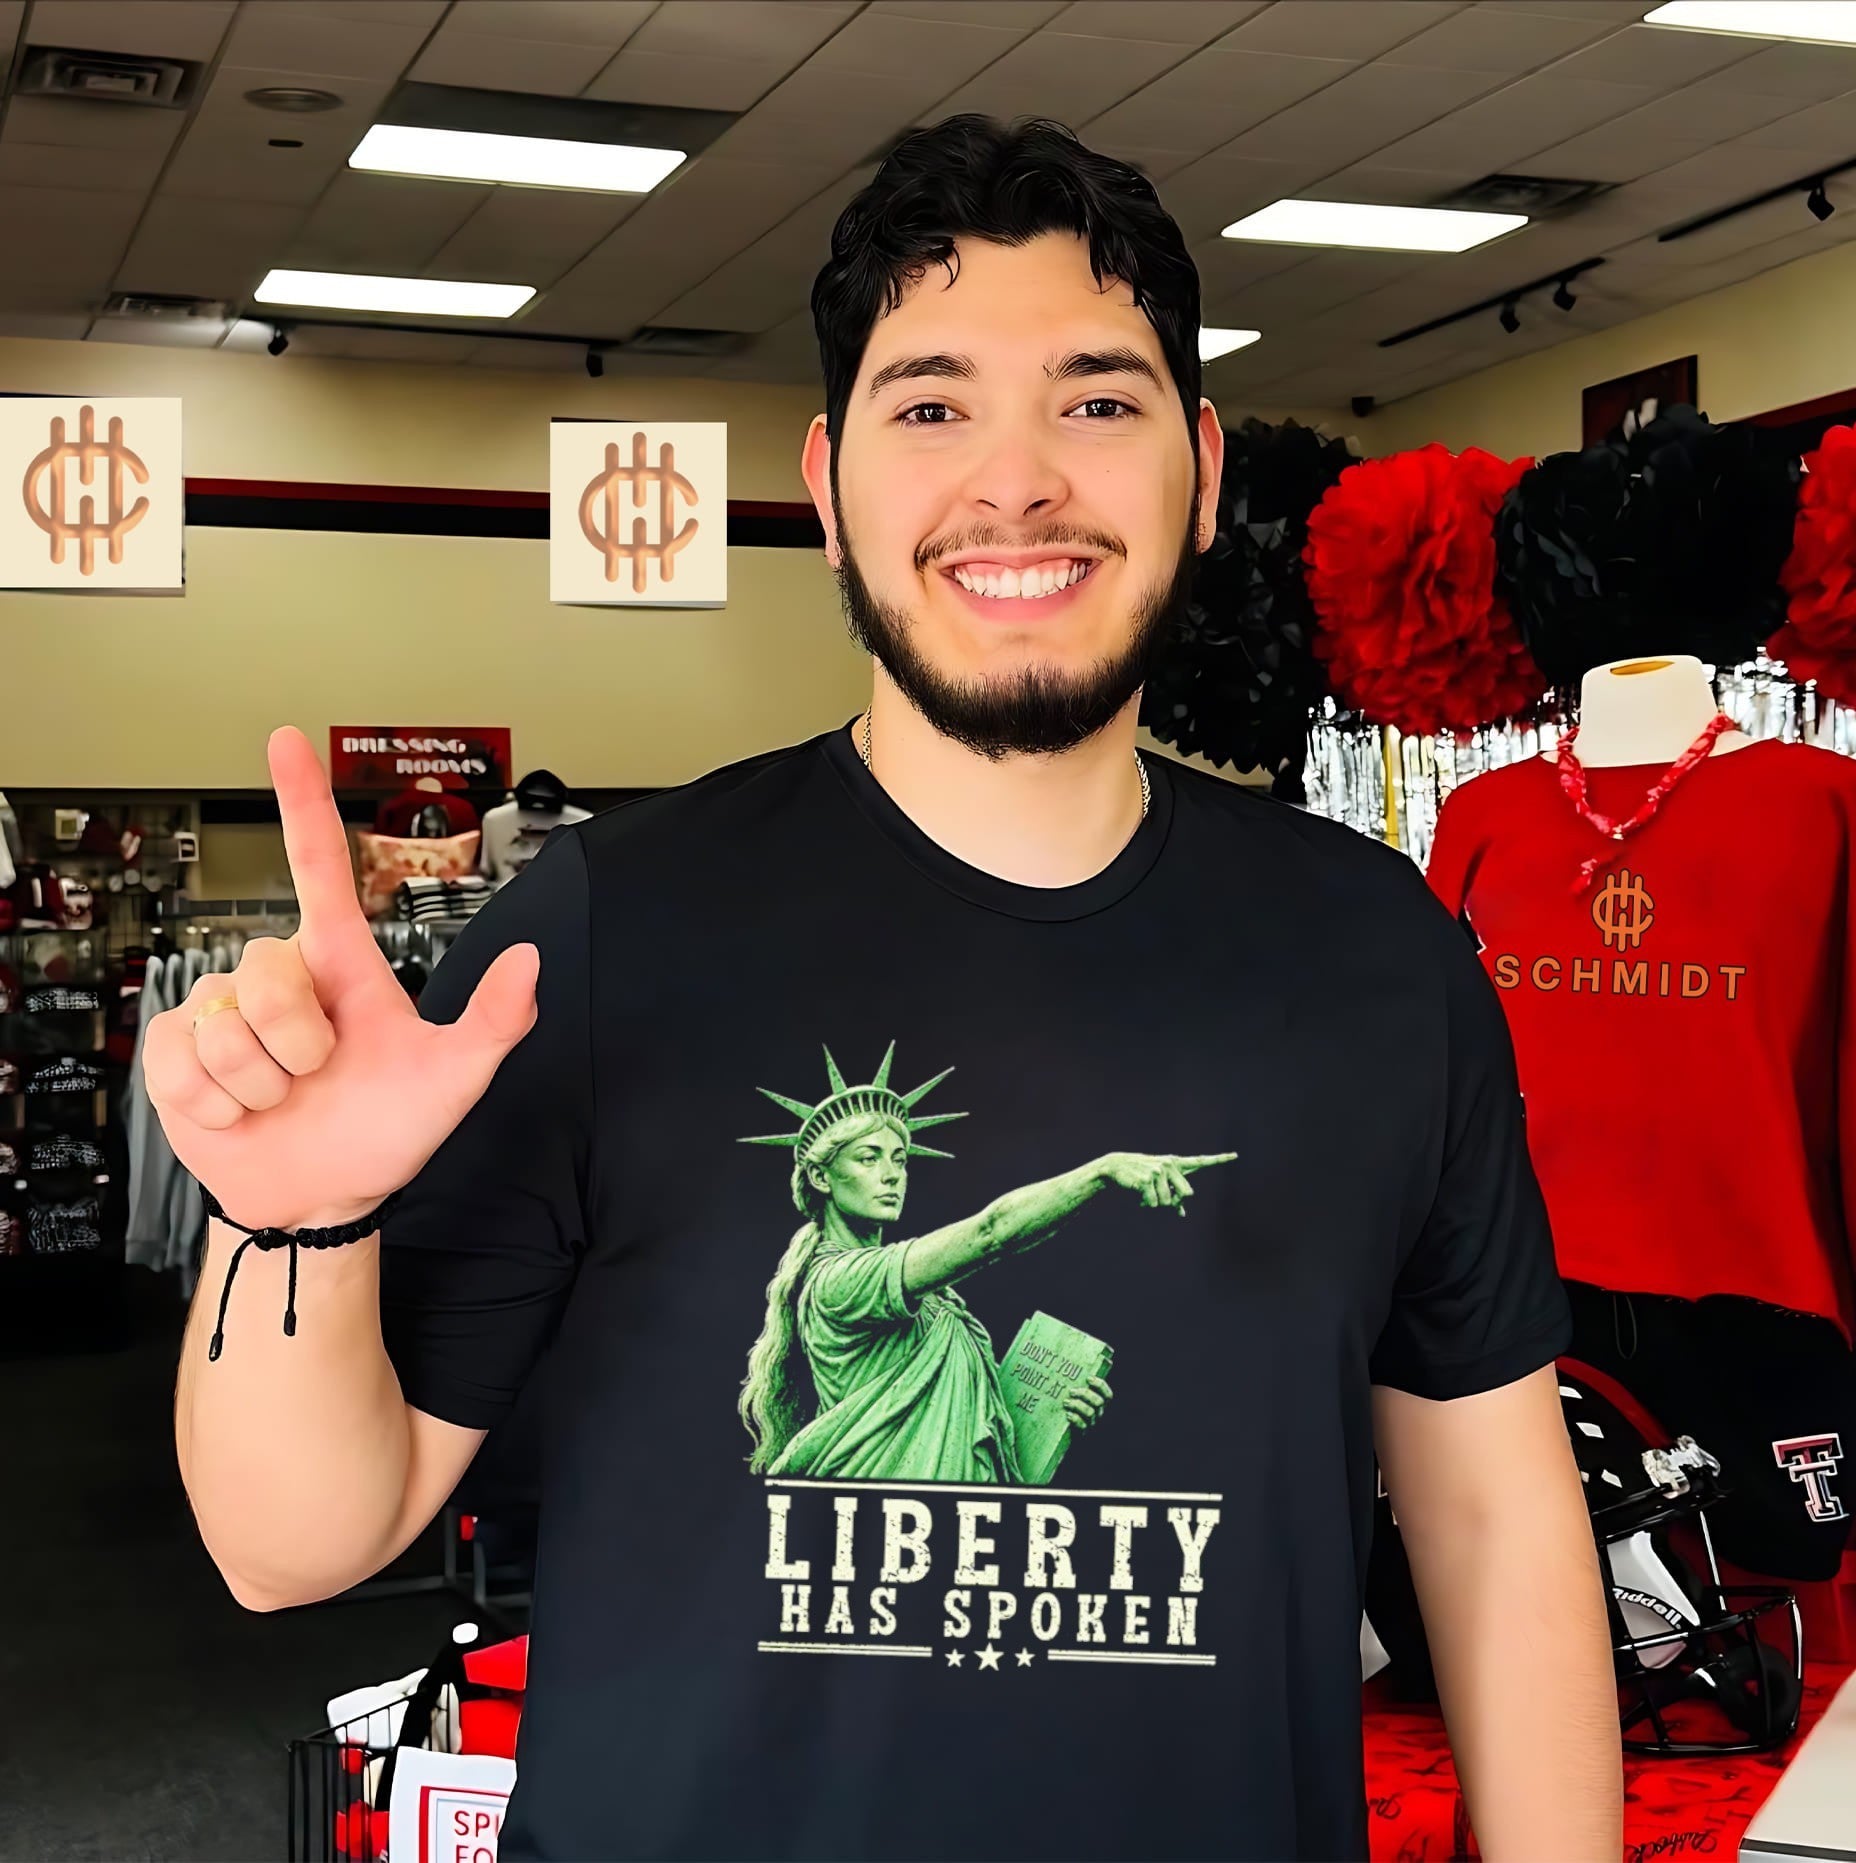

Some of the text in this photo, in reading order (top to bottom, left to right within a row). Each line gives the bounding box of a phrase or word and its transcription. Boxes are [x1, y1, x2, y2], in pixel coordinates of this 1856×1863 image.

[342, 737, 467, 753] DRESSING
[396, 758, 487, 775] ROOMS
[1494, 954, 1747, 1000] SCHMIDT
[1010, 1363, 1067, 1400] POINT AT
[1056, 1356, 1083, 1381] YOU
[1017, 1392, 1040, 1414] ME
[764, 1494, 1221, 1593] LIBERTY
[780, 1584, 1198, 1646] HAS SPOKEN
